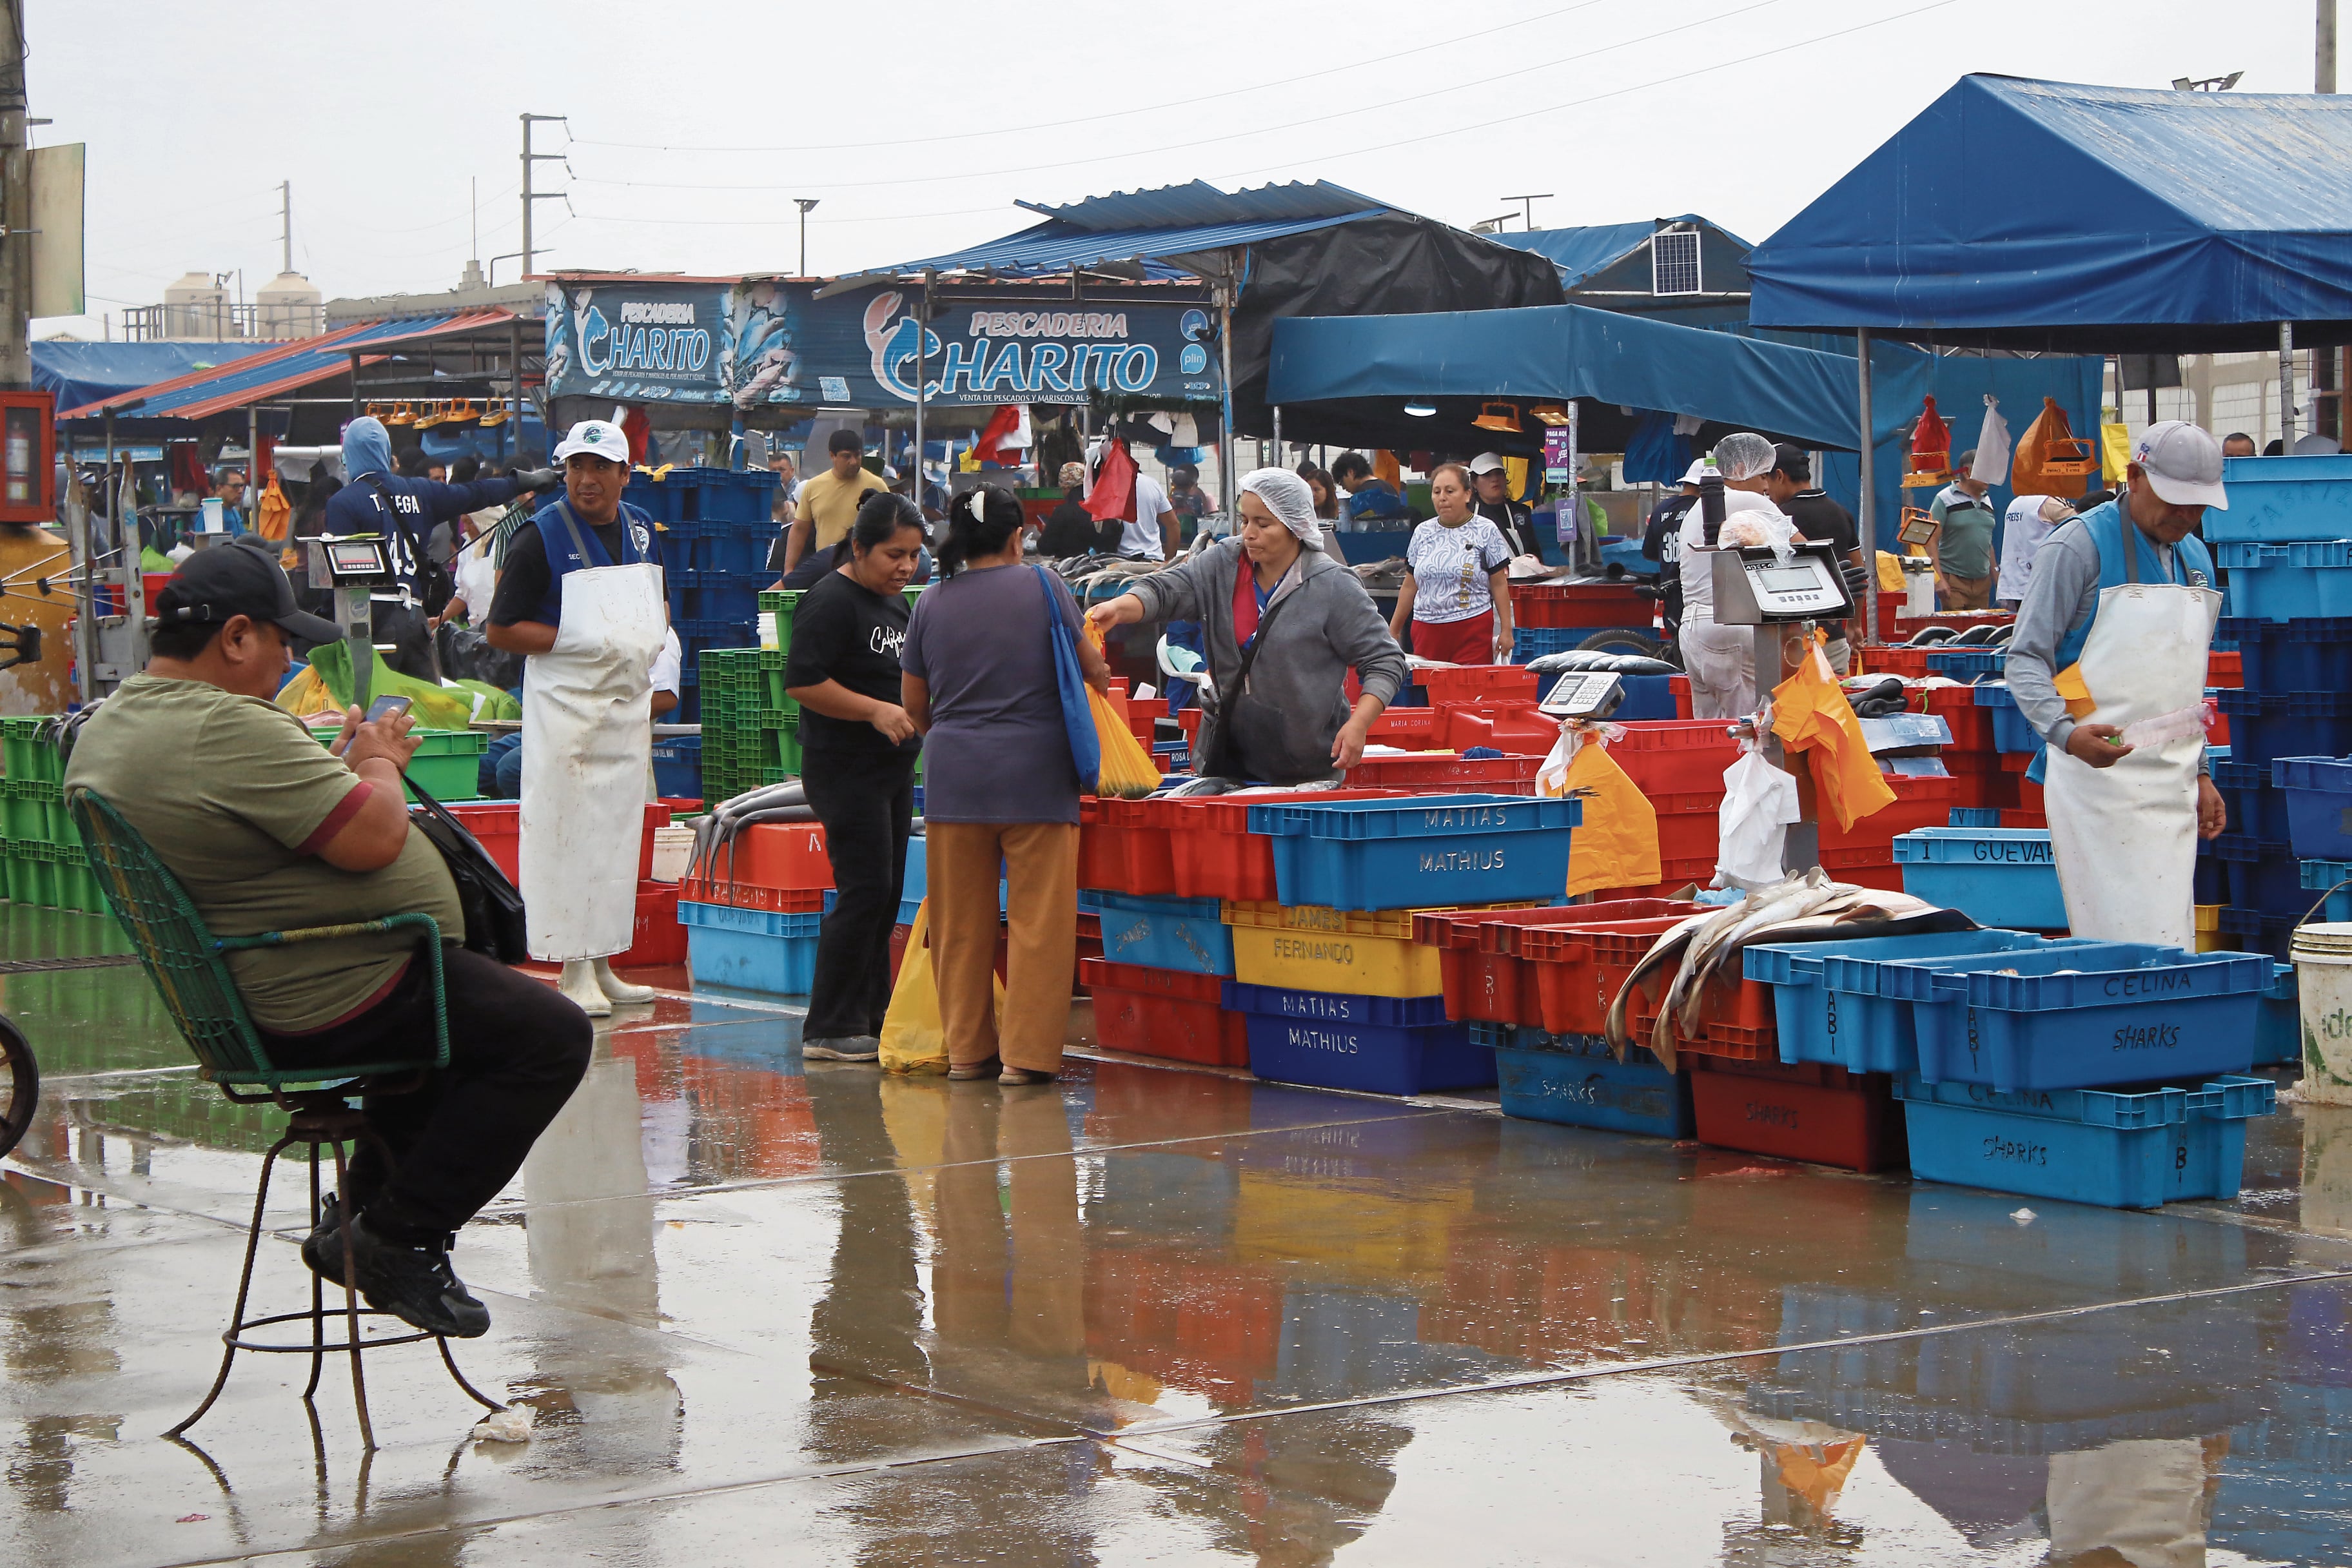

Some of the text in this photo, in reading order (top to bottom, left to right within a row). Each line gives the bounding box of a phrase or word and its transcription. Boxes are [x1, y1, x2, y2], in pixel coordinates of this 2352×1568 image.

[620, 302, 695, 325] PESCADERIA
[968, 311, 1128, 338] PESCADERIA
[1184, 353, 1202, 365] plin
[369, 493, 420, 514] T. EGA
[1171, 752, 1186, 763] ROSA
[1424, 807, 1506, 828] MATIAS
[1419, 848, 1505, 872] MATHIUS
[1289, 906, 1343, 929] JAMES
[1115, 917, 1151, 953] JAMES
[1274, 937, 1353, 965] FERNANDO
[2104, 973, 2191, 997] CELINA
[1282, 995, 1350, 1019] MATIAS
[1289, 1027, 1358, 1054] MATHIUS
[2113, 1023, 2180, 1052] SHARKS
[1983, 1135, 2047, 1166] SHARKS
